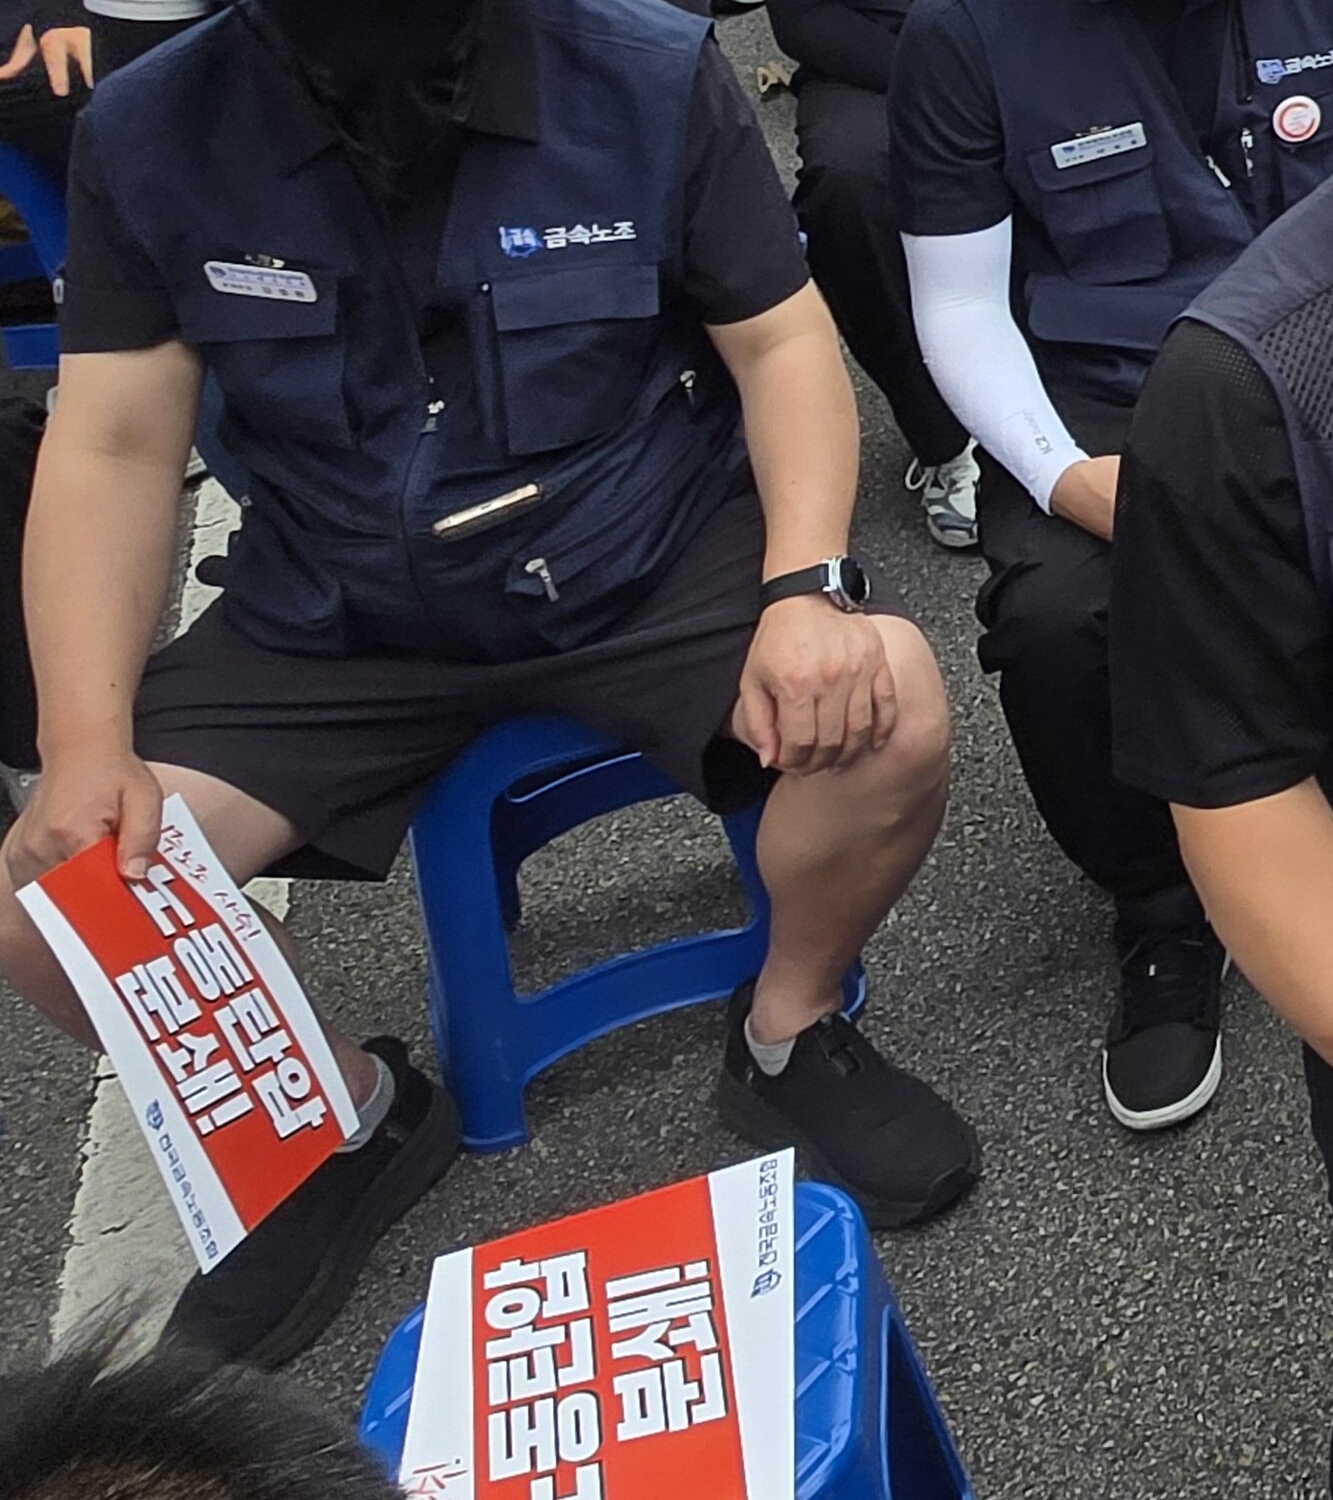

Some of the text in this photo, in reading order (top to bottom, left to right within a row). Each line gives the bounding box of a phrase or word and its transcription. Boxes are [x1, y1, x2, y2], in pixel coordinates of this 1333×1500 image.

[543, 221, 637, 249] 금속노조
[115, 955, 254, 1136] 분쇄!
[133, 865, 327, 1139] 노동탄압
[758, 1158, 778, 1268] 전국금속노동조합
[606, 1261, 727, 1442] 분쇄!
